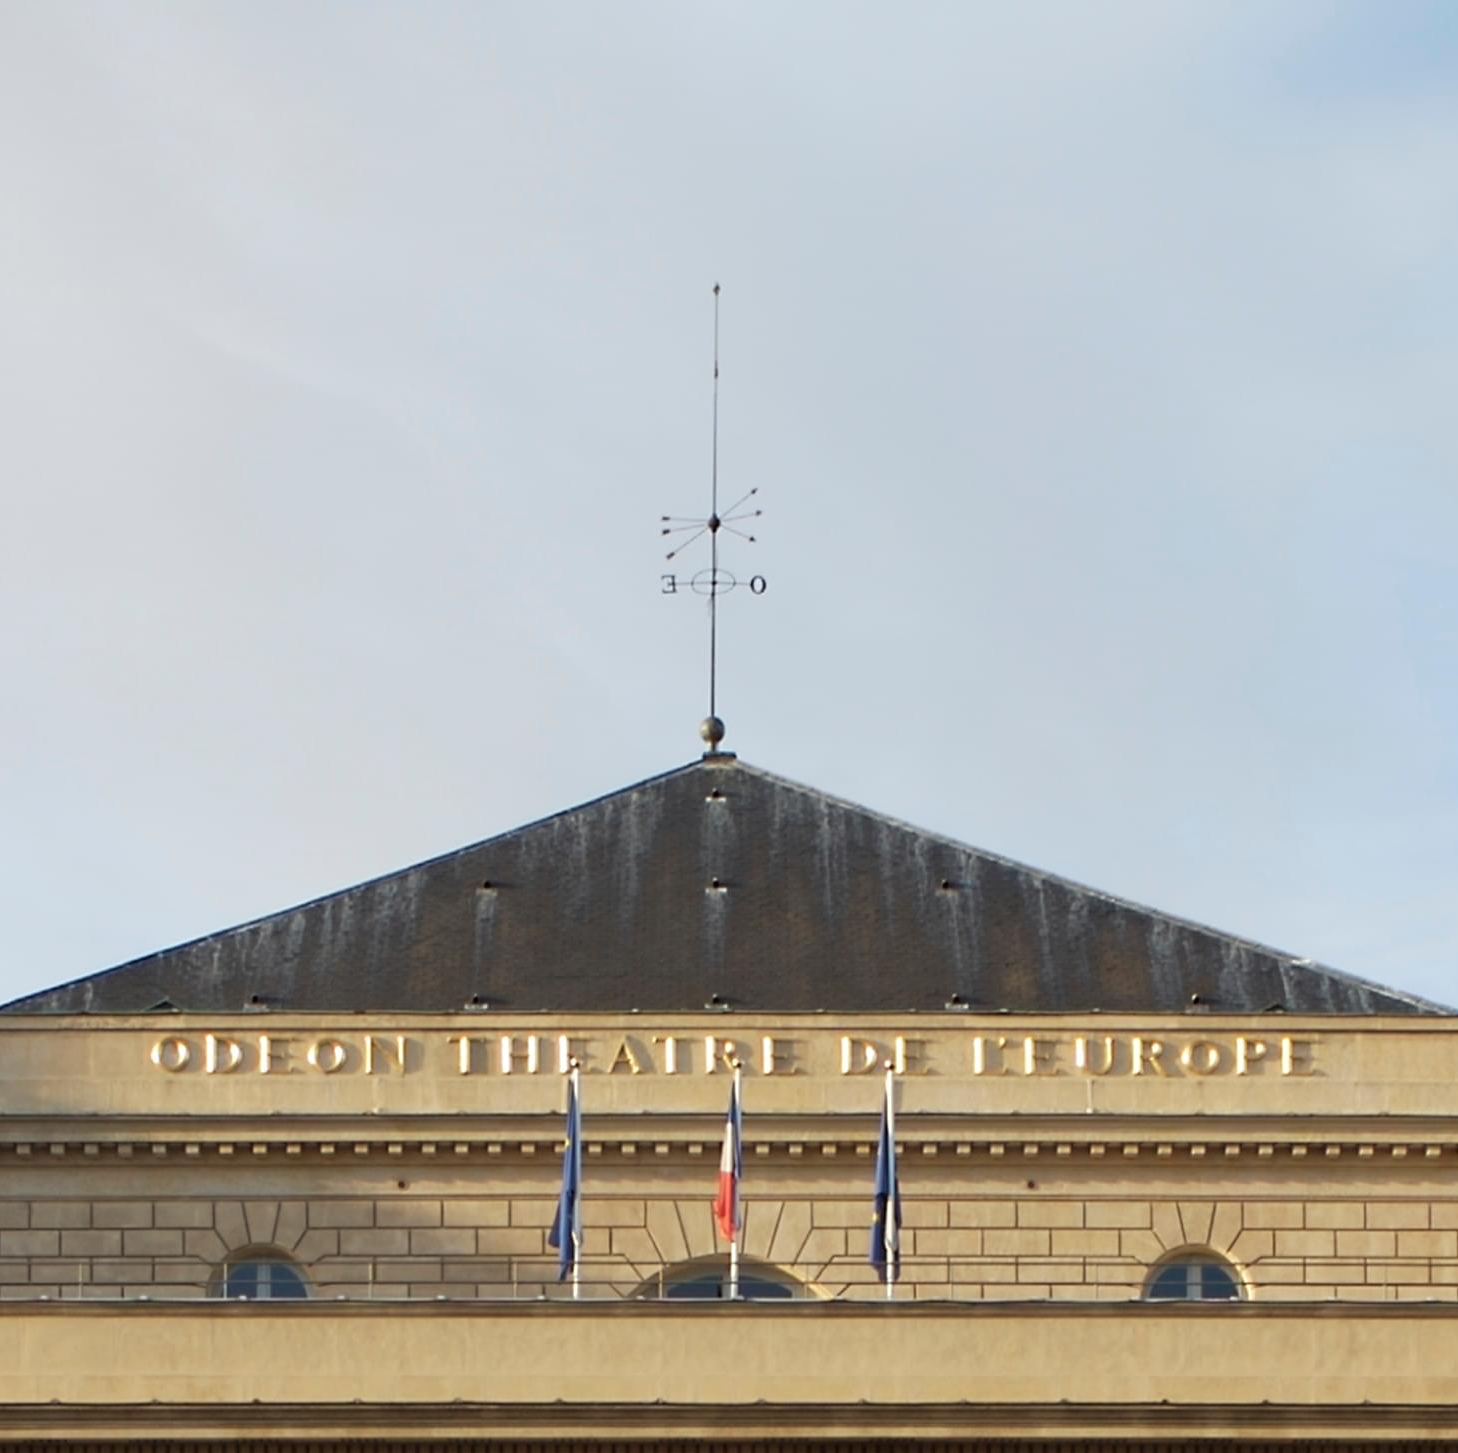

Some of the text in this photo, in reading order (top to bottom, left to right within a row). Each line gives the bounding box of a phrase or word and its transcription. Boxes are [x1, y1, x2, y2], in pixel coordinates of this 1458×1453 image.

[749, 575, 767, 595] O
[150, 1034, 1317, 1077] ODEON THEATRE DE L'EUROPE
